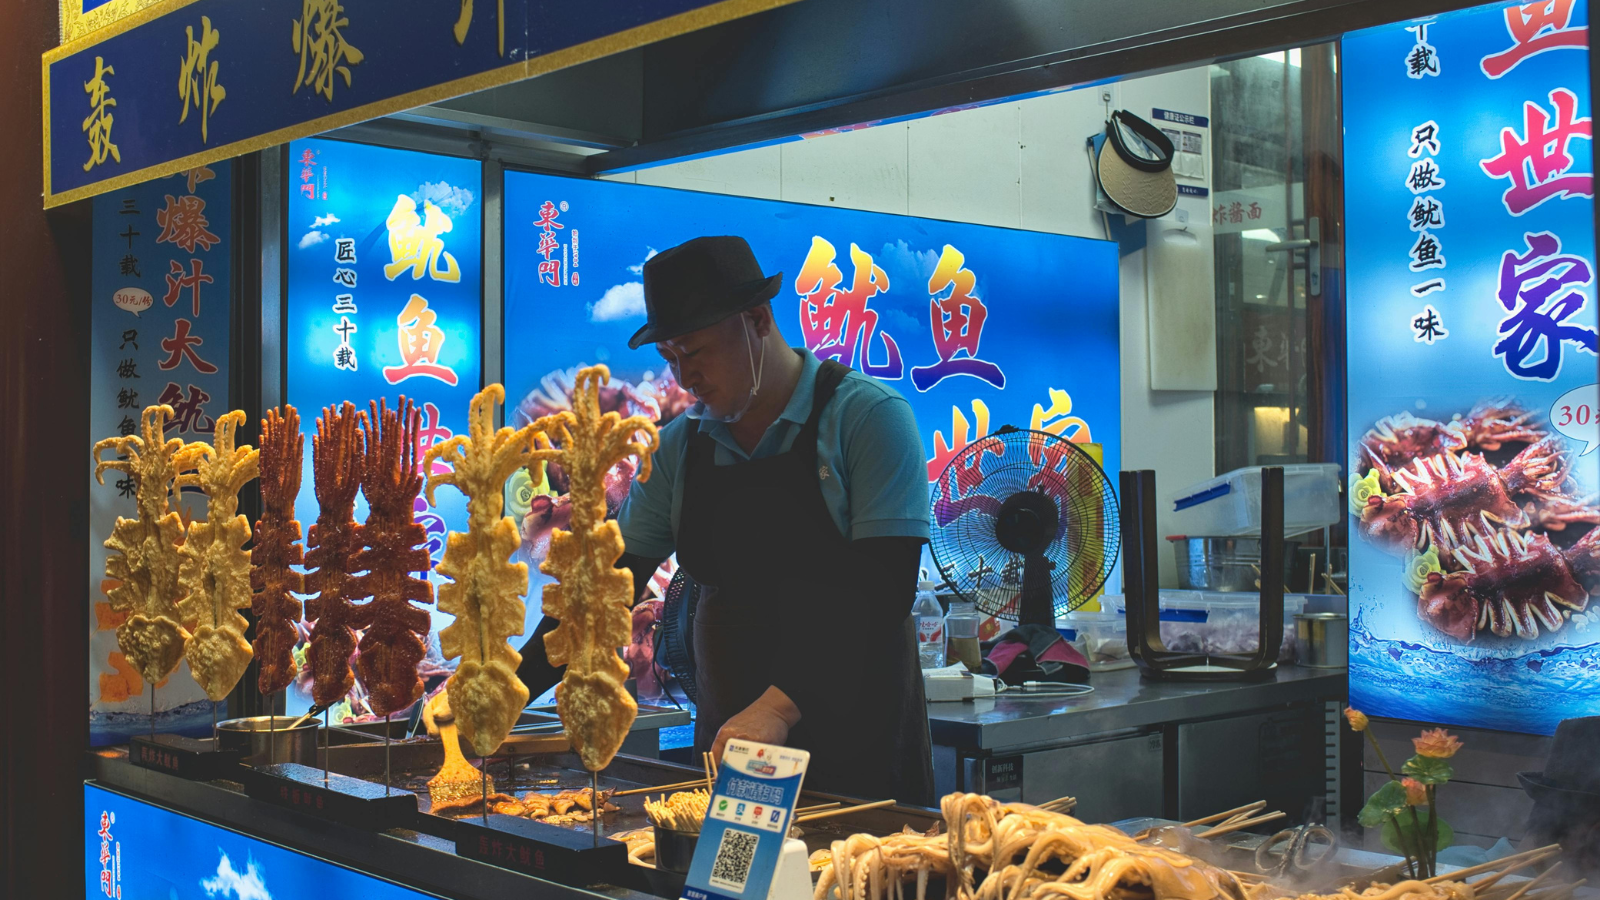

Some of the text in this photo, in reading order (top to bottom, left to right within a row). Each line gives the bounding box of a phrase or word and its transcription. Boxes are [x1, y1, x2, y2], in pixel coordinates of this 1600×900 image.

[533, 201, 564, 287] 東華門
[1409, 124, 1446, 342] 只做鱿鱼一味
[333, 238, 358, 371] 匠心三十载
[795, 235, 1006, 392] 鱿鱼
[726, 777, 784, 805] 付款请扫码
[98, 811, 117, 898] 東華門
[479, 835, 546, 870] 轰炸大鱿鱼
